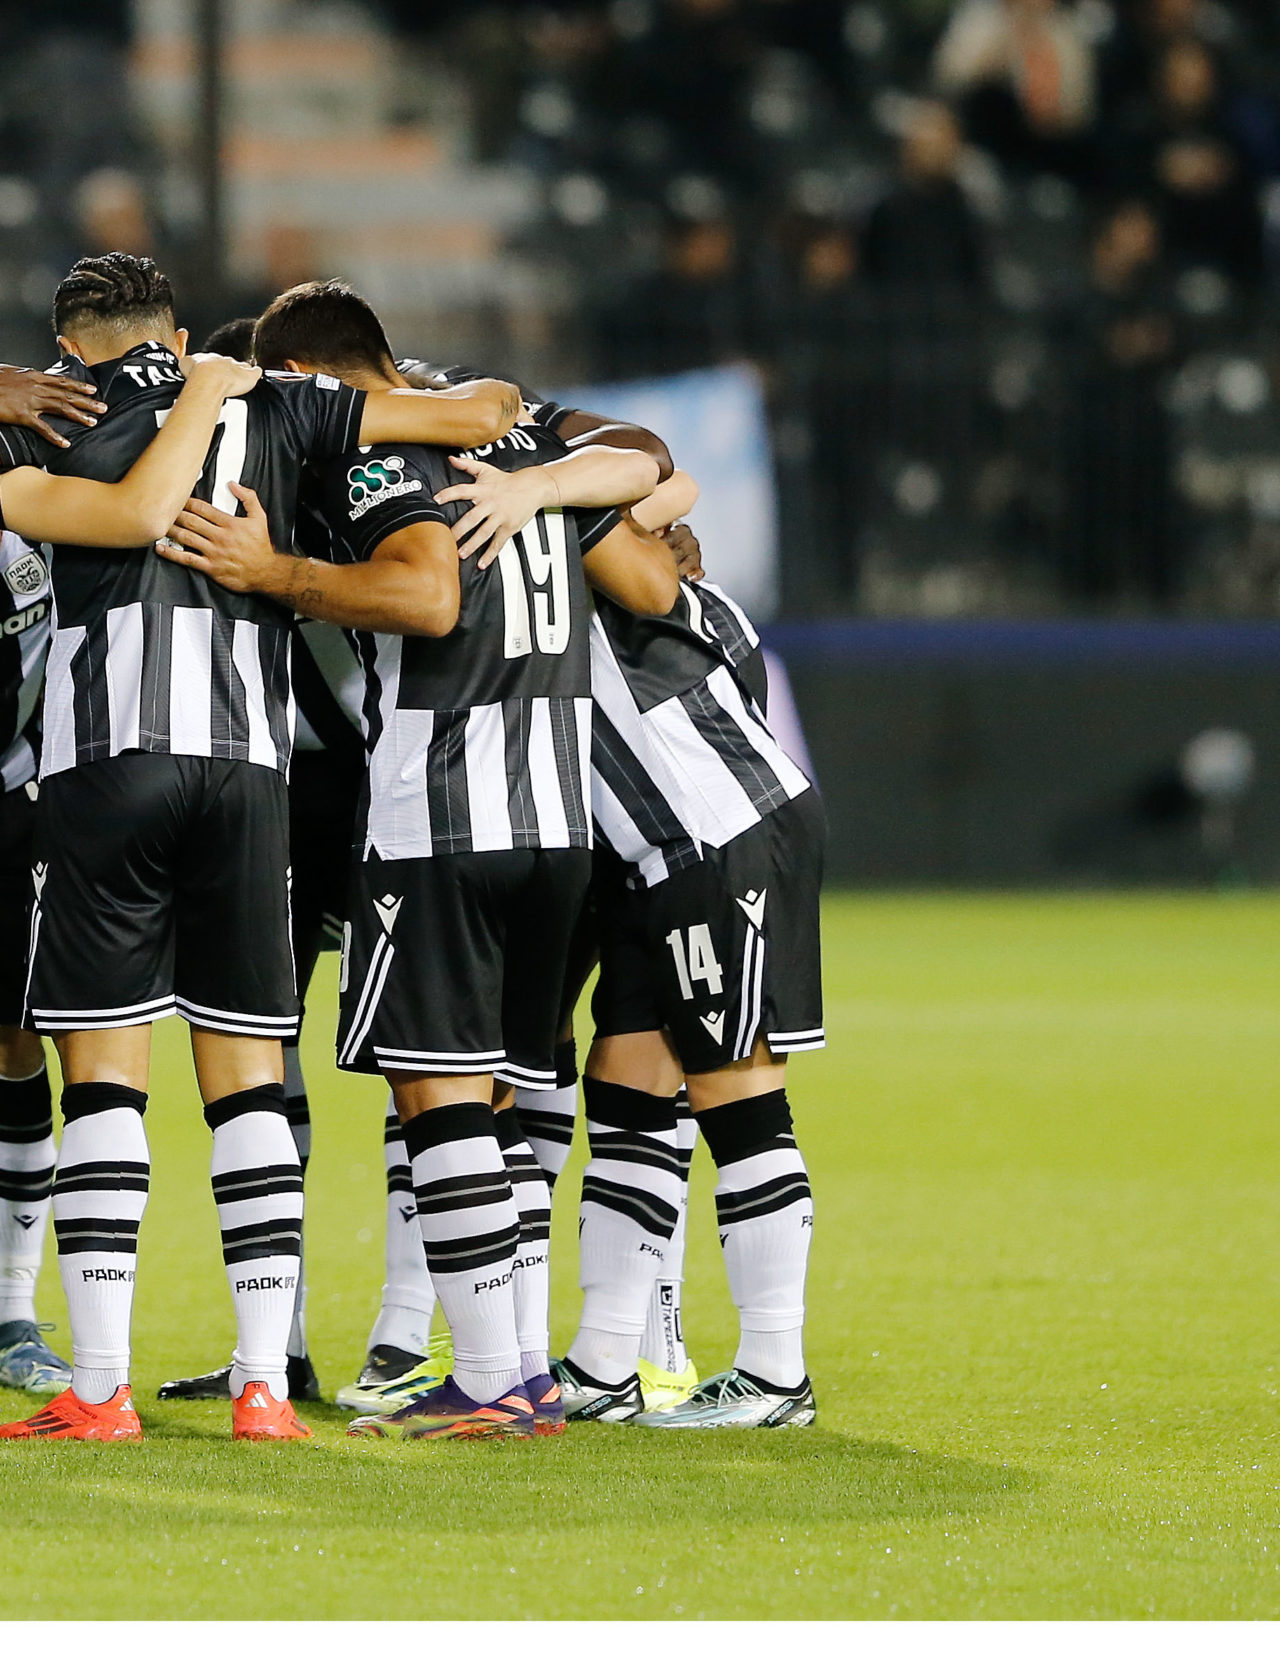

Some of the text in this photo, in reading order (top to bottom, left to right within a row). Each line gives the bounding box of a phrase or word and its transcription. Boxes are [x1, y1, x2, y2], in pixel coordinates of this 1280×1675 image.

[122, 365, 186, 387] TAI
[497, 512, 572, 660] 19
[666, 922, 724, 1000] 14
[82, 1269, 127, 1282] PAOK
[236, 1276, 283, 1293] PAOK
